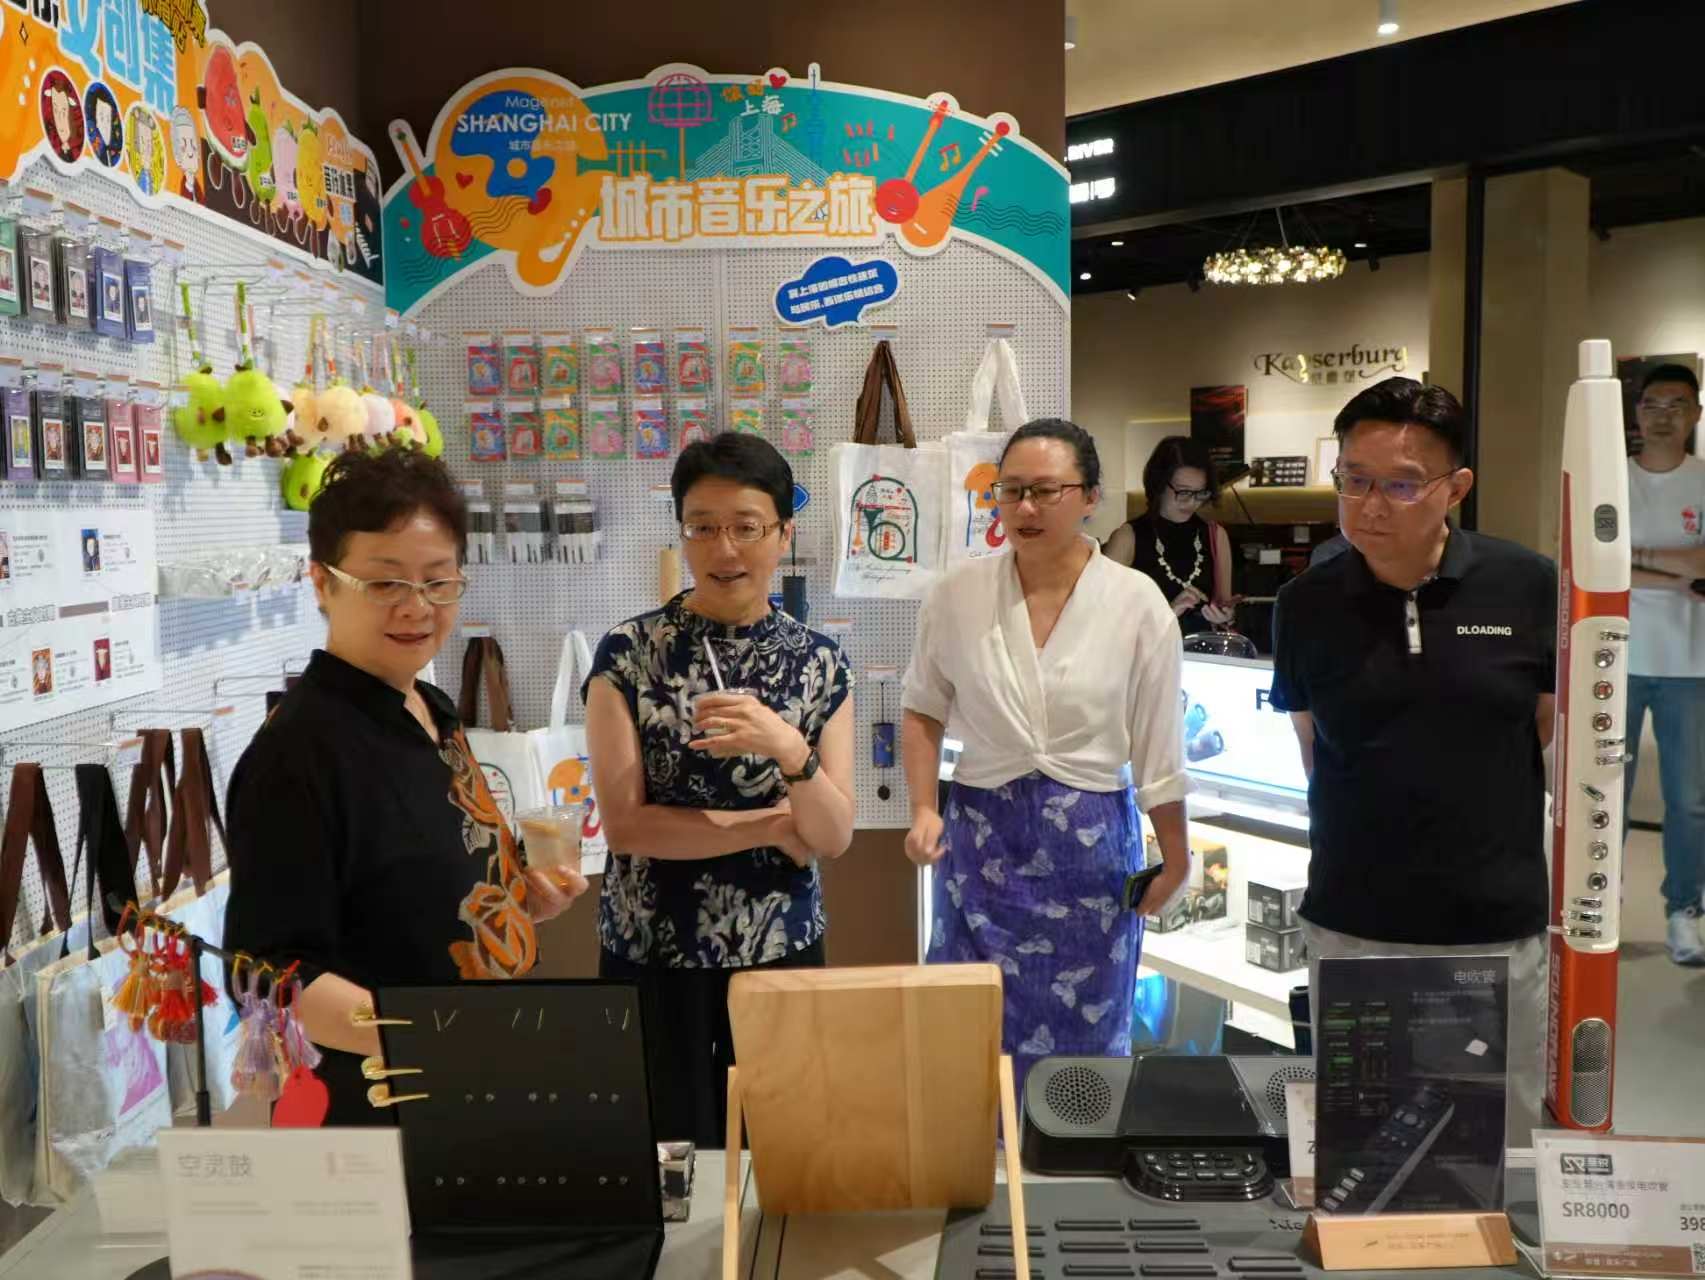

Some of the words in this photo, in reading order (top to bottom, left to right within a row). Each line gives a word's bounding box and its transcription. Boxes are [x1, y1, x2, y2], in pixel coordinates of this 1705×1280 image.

[741, 95, 784, 116] 上海
[457, 113, 577, 133] SHANGHAI
[584, 112, 631, 132] CITY
[600, 174, 875, 240] 城市音乐之旅
[1456, 625, 1512, 636] DLOADING
[177, 1152, 252, 1179] 空灵鼓
[1562, 1201, 1630, 1219] SR8000
